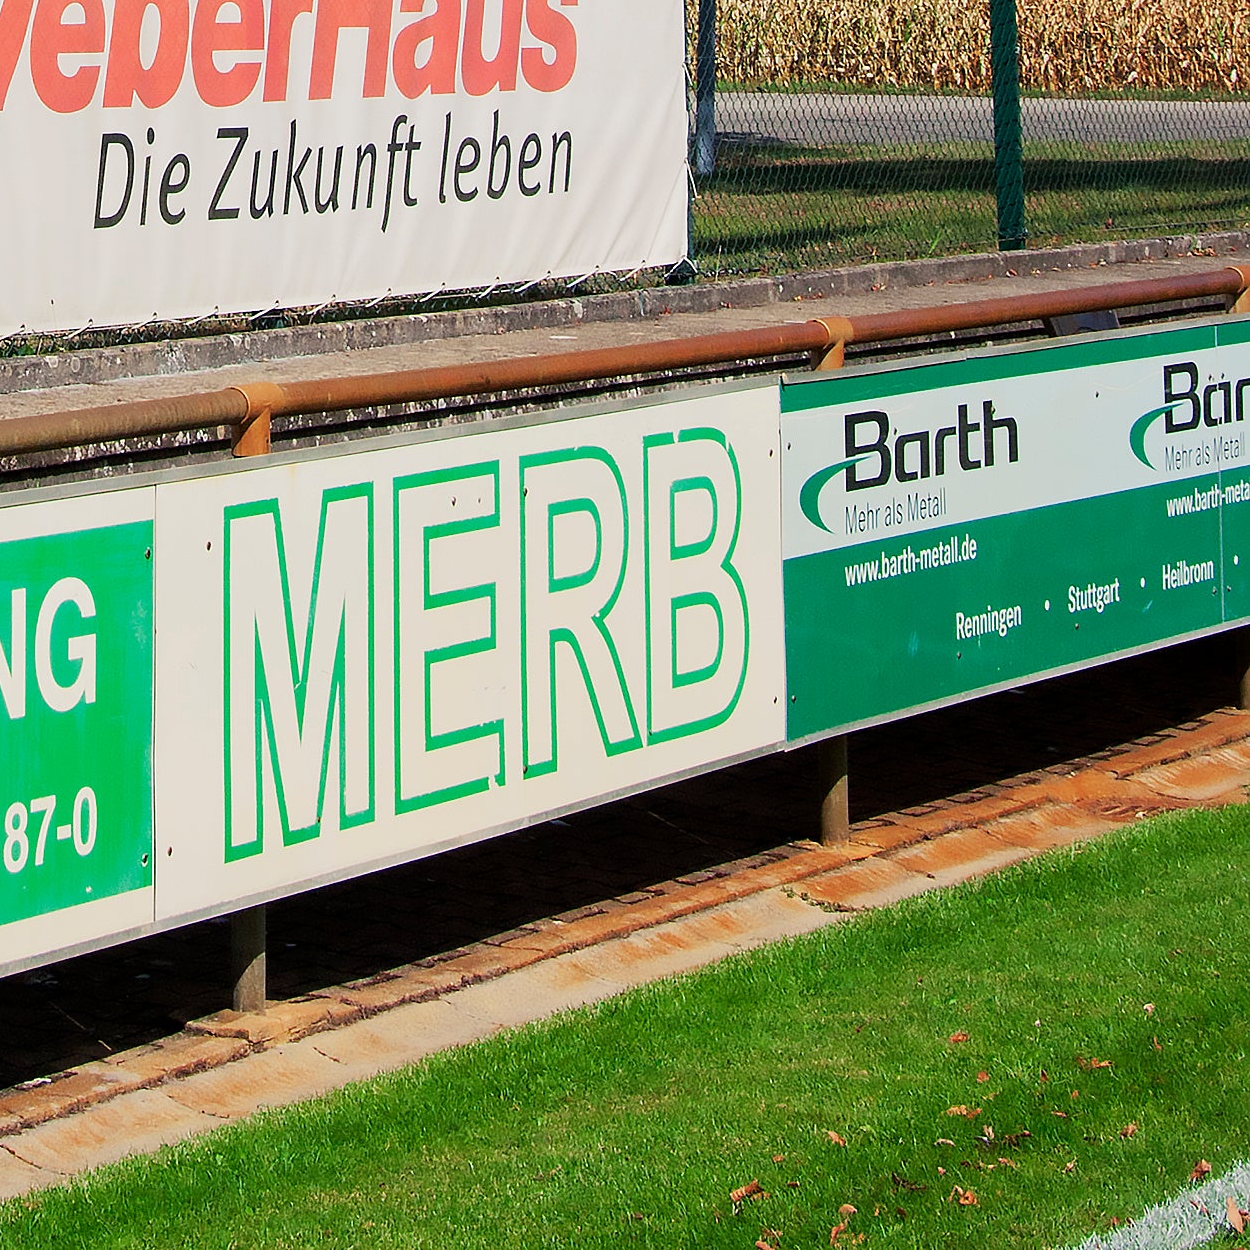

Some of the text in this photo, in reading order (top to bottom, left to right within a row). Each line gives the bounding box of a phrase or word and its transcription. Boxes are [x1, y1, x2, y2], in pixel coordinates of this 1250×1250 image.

[93, 110, 573, 233] Die Zukunft leben
[844, 400, 1019, 492] Barth
[1165, 431, 1246, 472] Mehr als Metall
[845, 487, 947, 535] Mehr als Metall
[844, 533, 977, 587] www.barth-metall.de
[955, 560, 1214, 640] Renningen Stuttgart Heilbronn
[223, 426, 750, 864] MERB
